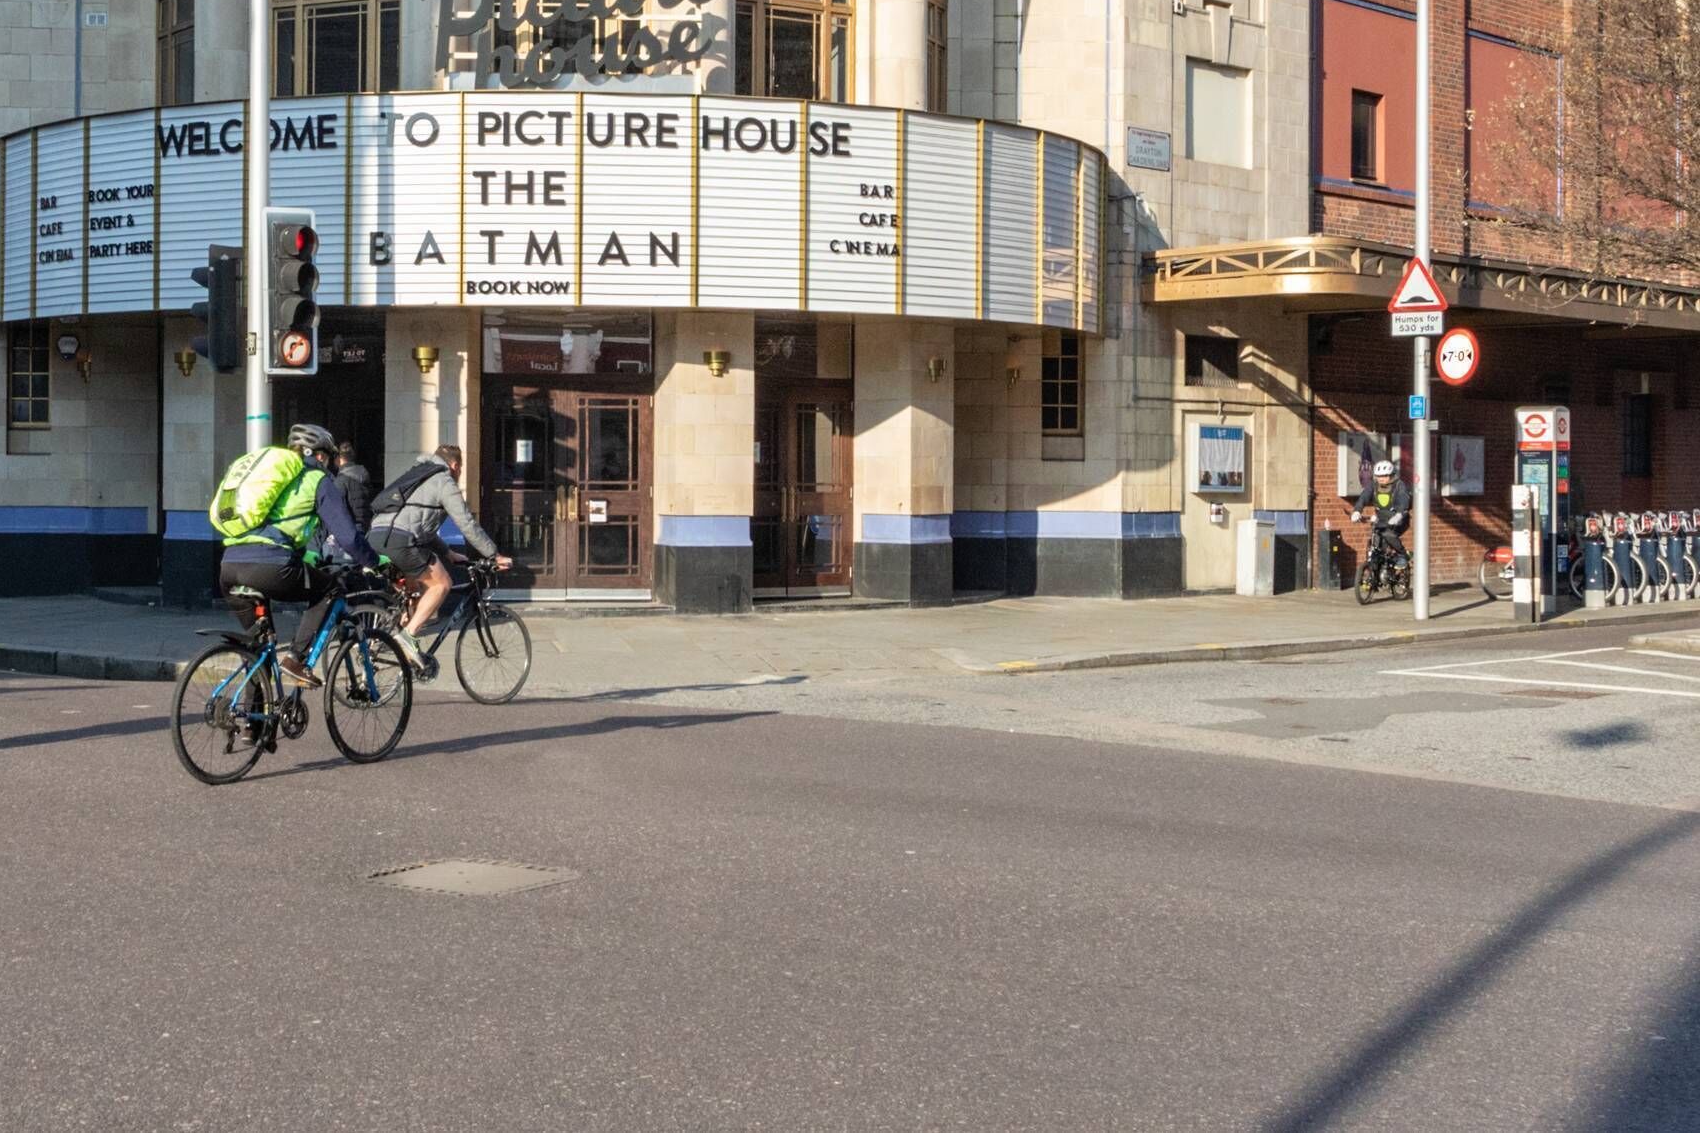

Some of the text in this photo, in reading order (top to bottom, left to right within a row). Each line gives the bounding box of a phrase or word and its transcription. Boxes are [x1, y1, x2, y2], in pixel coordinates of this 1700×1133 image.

[475, 20, 715, 90] house
[379, 111, 441, 148] TO
[702, 116, 852, 157] HOUSE
[88, 184, 154, 203] BOOK YOUR
[472, 170, 567, 206] THE
[859, 183, 894, 199] BAR
[40, 196, 57, 210] BAR
[90, 214, 135, 231] EVENT &
[859, 212, 900, 227] CAFE
[40, 222, 63, 237] CAFE
[39, 248, 75, 265] CINEMA
[89, 240, 154, 259] PARTY HERE
[829, 240, 901, 257] CINEMA
[466, 280, 570, 296] BOOK NOW
[1395, 314, 1439, 324] Humps for
[1420, 324, 1435, 333] yds
